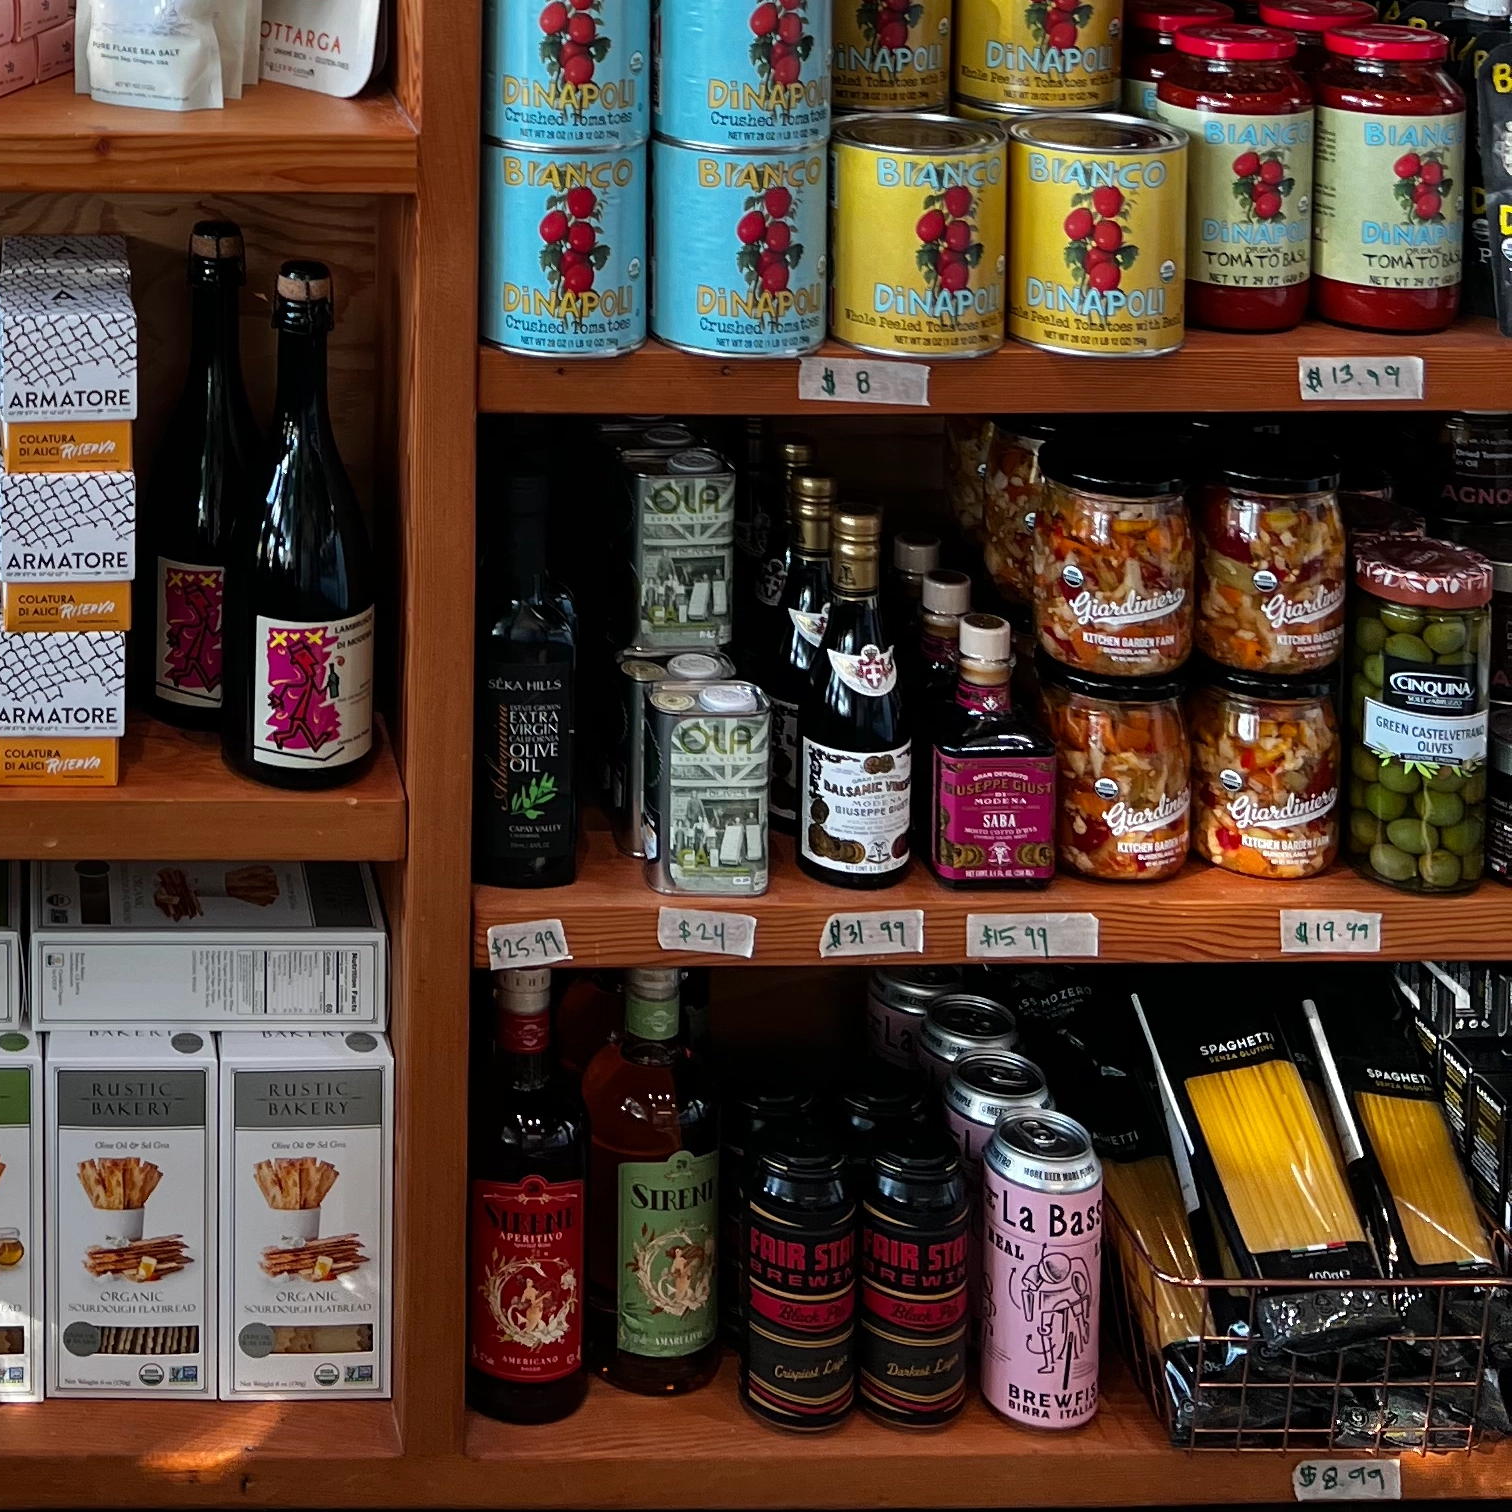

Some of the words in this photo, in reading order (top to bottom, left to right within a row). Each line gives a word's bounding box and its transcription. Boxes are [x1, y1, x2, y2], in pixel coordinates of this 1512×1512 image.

[260, 22, 342, 56] OTTARGA
[93, 41, 113, 52] PURE
[115, 43, 137, 55] FLAKE
[139, 46, 155, 56] SEA
[159, 48, 180, 58] SALT
[505, 108, 566, 127] Crushed
[571, 111, 633, 127] Tomatoes
[503, 156, 633, 188] BIANCO
[1028, 154, 1166, 189] BIANCO
[8, 390, 130, 407] ARMATORE
[19, 435, 76, 446] COLATURA
[19, 447, 29, 457] DI
[32, 446, 59, 457] ALICI
[60, 440, 117, 460] RISERVA
[1083, 632, 1120, 648] KITCHEN
[1122, 634, 1154, 648] GARDEN
[1156, 634, 1175, 646] FARM
[1398, 674, 1471, 696] CINQUINA
[509, 710, 559, 725] EXTRA
[1376, 716, 1409, 731] GREEN
[509, 723, 559, 737] VIRGIN
[509, 742, 559, 759] OLIVE
[1417, 740, 1453, 755] OLIVES
[509, 758, 541, 774] OIL
[983, 814, 1016, 827] SABA
[677, 920, 725, 952] $24
[827, 918, 905, 952] $31.99
[1294, 922, 1369, 943] $19.99
[491, 932, 559, 958] $25.99
[1199, 1031, 1274, 1057] SPAGHETTI
[91, 1082, 172, 1097] RUSTIC
[91, 1101, 172, 1117] BAKERY
[1001, 1199, 1035, 1233] La
[498, 1230, 563, 1242] APERITIVO
[750, 1229, 806, 1268] FAIR
[501, 1355, 559, 1367] AMERICANO
[1298, 1466, 1385, 1490] $8.99
